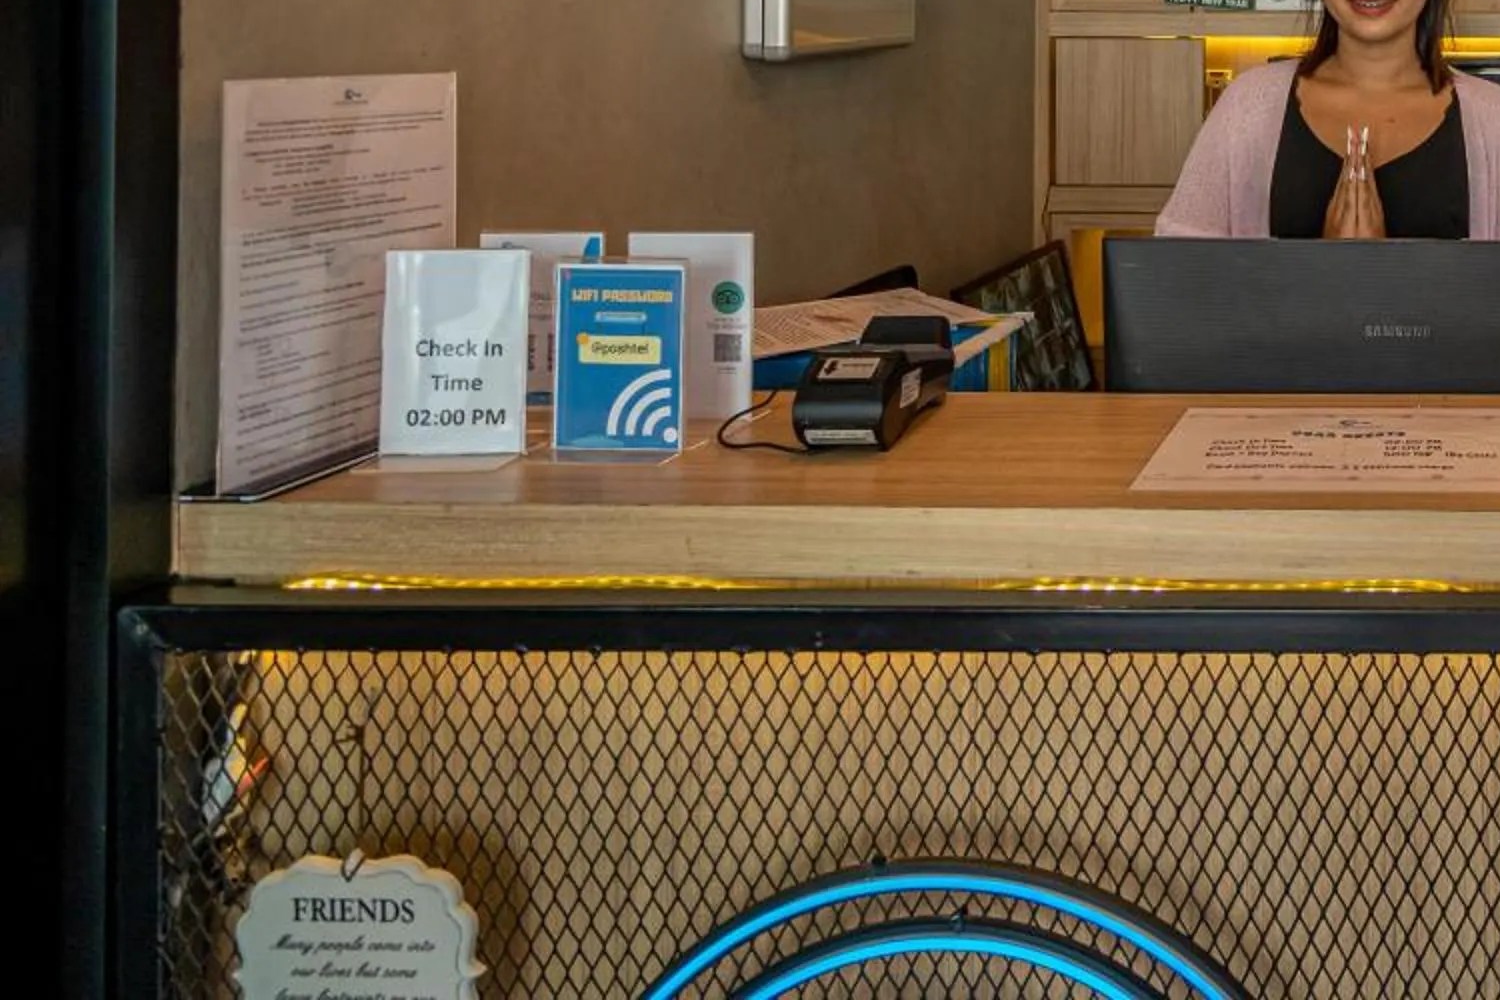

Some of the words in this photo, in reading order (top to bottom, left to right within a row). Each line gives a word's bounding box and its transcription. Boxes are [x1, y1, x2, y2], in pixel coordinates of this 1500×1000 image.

[571, 288, 599, 303] WIFI
[602, 289, 673, 304] PASSWORD
[1364, 324, 1431, 338] SAMSUNG
[415, 338, 478, 359] Check
[484, 339, 504, 358] In
[591, 341, 649, 357] @poshtel
[431, 374, 484, 392] Time
[406, 408, 466, 427] 02:00
[471, 407, 507, 426] PM
[291, 897, 416, 924] FRIENDS
[269, 933, 314, 955] Many
[313, 934, 365, 956] people
[367, 939, 404, 952] come
[405, 938, 437, 953] into
[290, 967, 317, 979] our
[317, 960, 353, 979] lives
[354, 960, 381, 979] but
[381, 968, 418, 980] some
